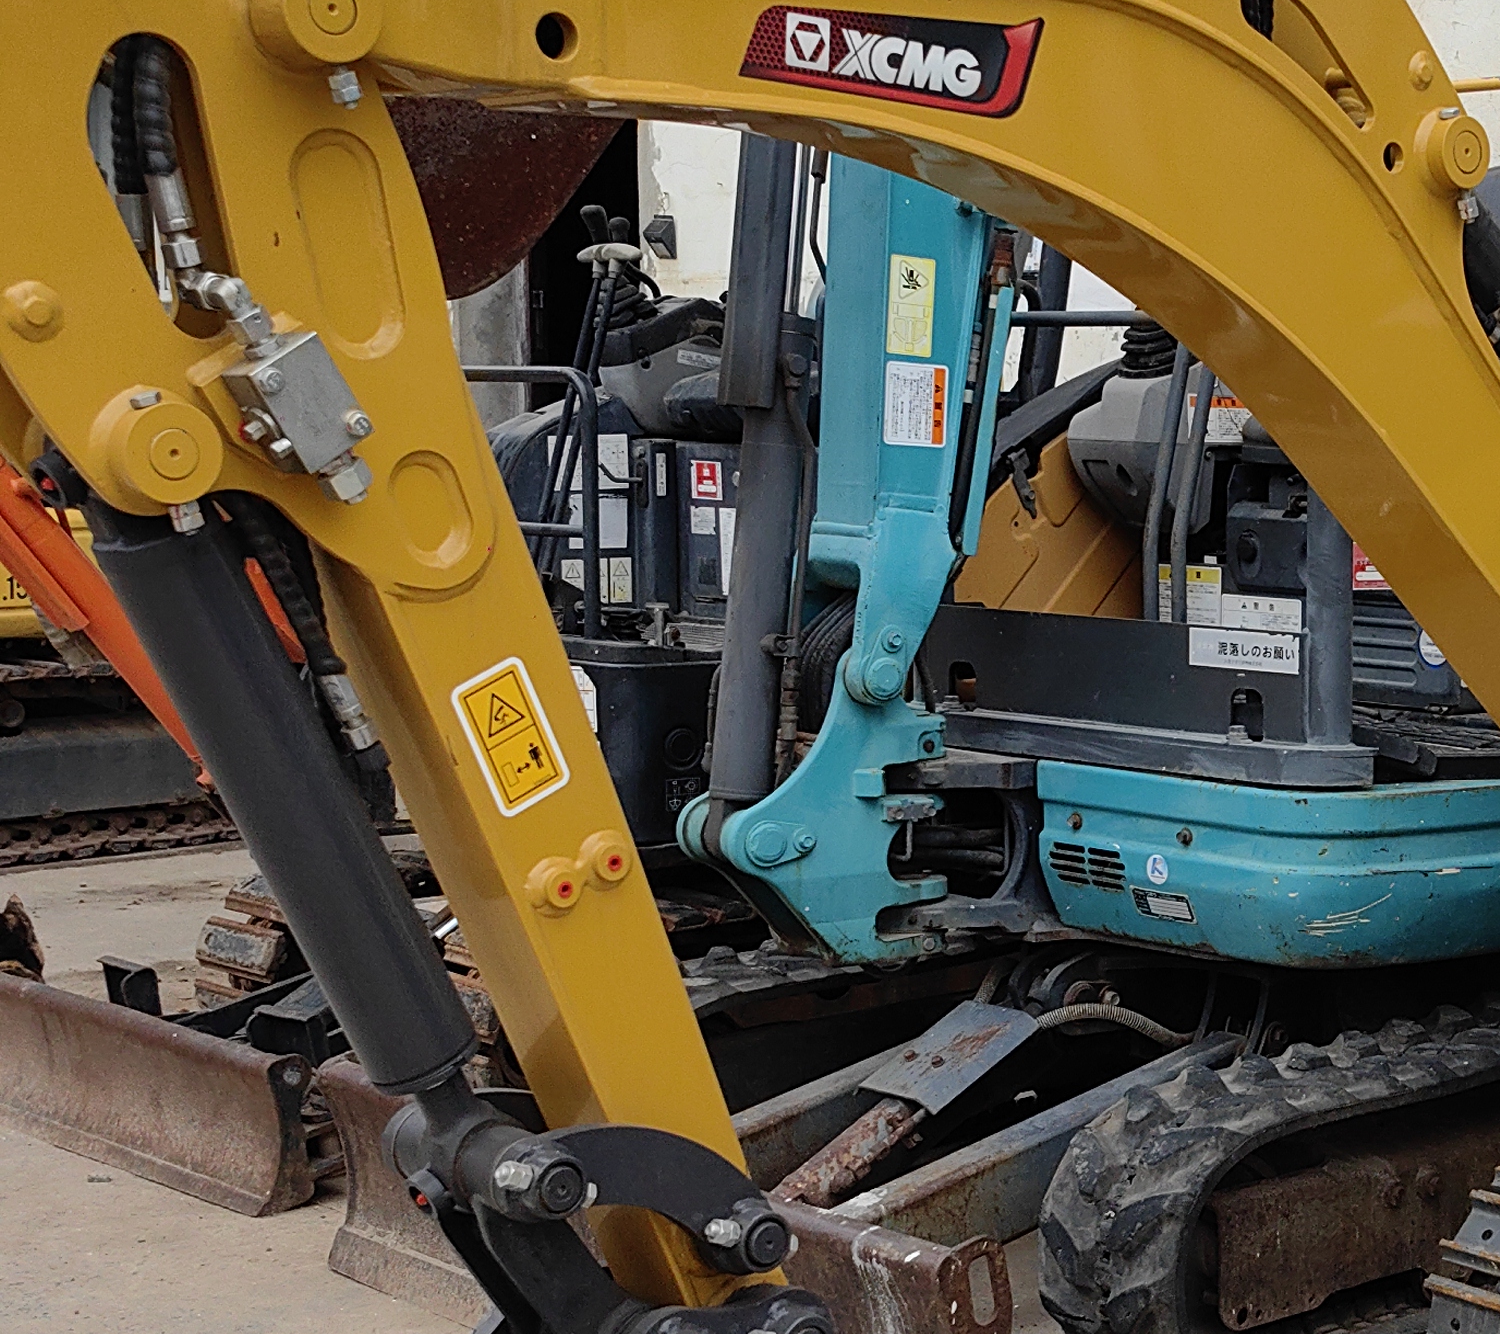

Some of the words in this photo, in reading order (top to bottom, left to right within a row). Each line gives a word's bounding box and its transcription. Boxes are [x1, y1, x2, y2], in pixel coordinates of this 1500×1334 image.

[832, 28, 982, 98] XCMG
[1218, 641, 1296, 660] 泥落しのお願い
